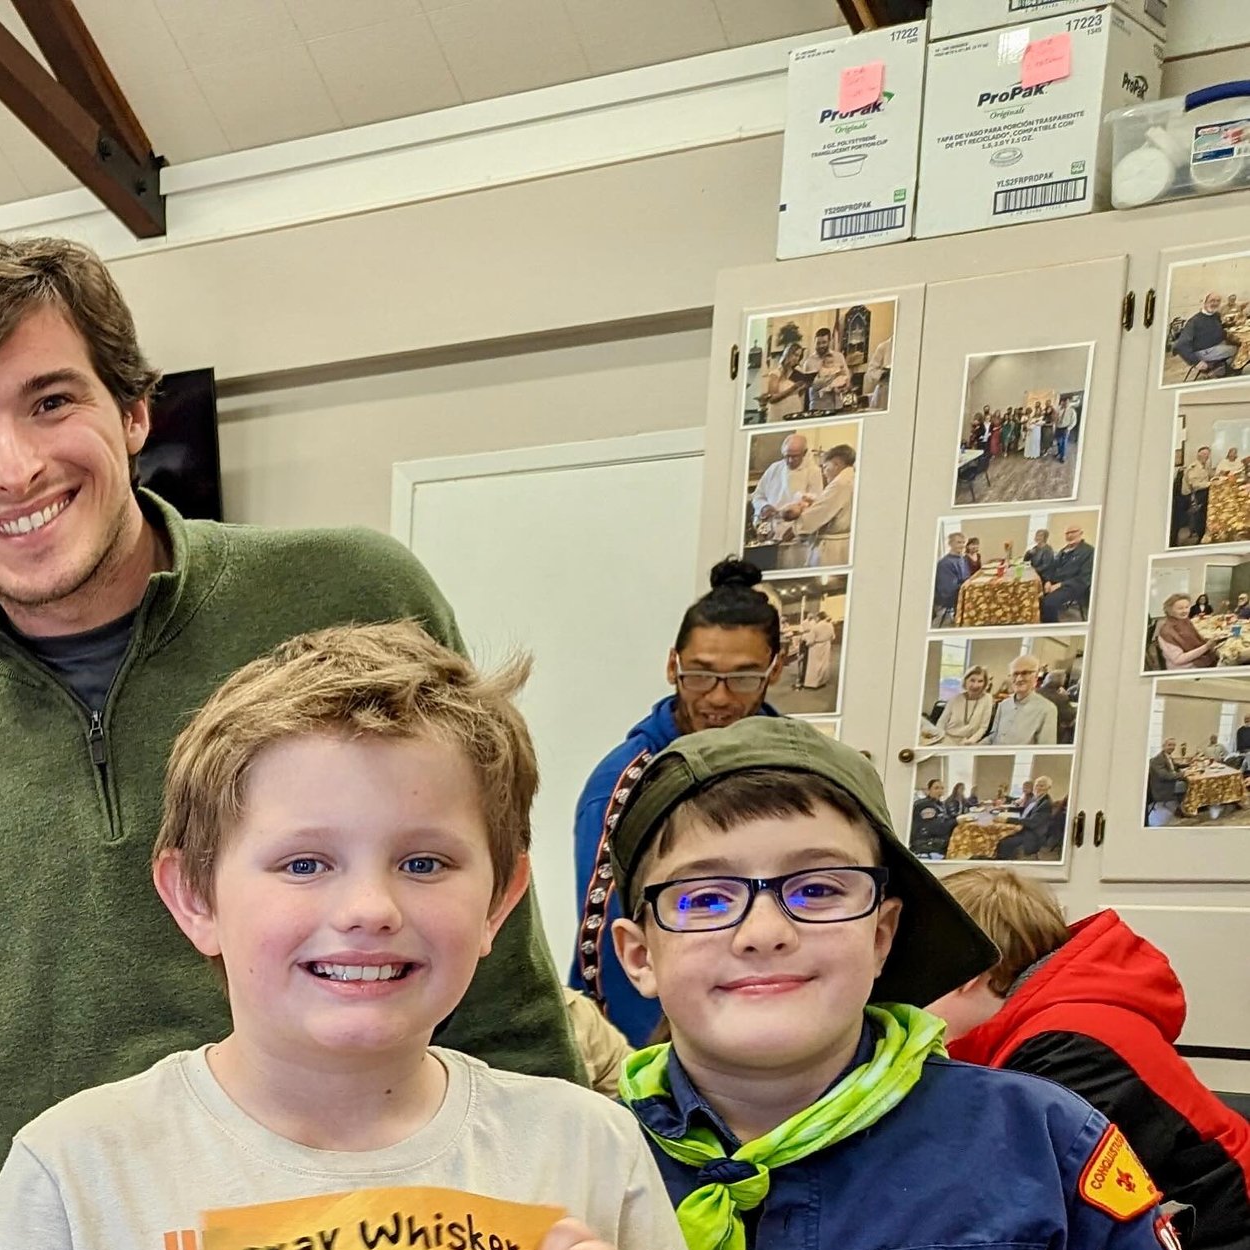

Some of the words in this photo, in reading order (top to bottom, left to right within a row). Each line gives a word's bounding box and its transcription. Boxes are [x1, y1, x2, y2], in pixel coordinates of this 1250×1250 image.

[1066, 15, 1102, 32] 17223
[890, 27, 918, 41] 17222
[977, 84, 1046, 107] ProPak
[965, 129, 984, 139] VASO
[1035, 110, 1085, 126] TRASPARENTE
